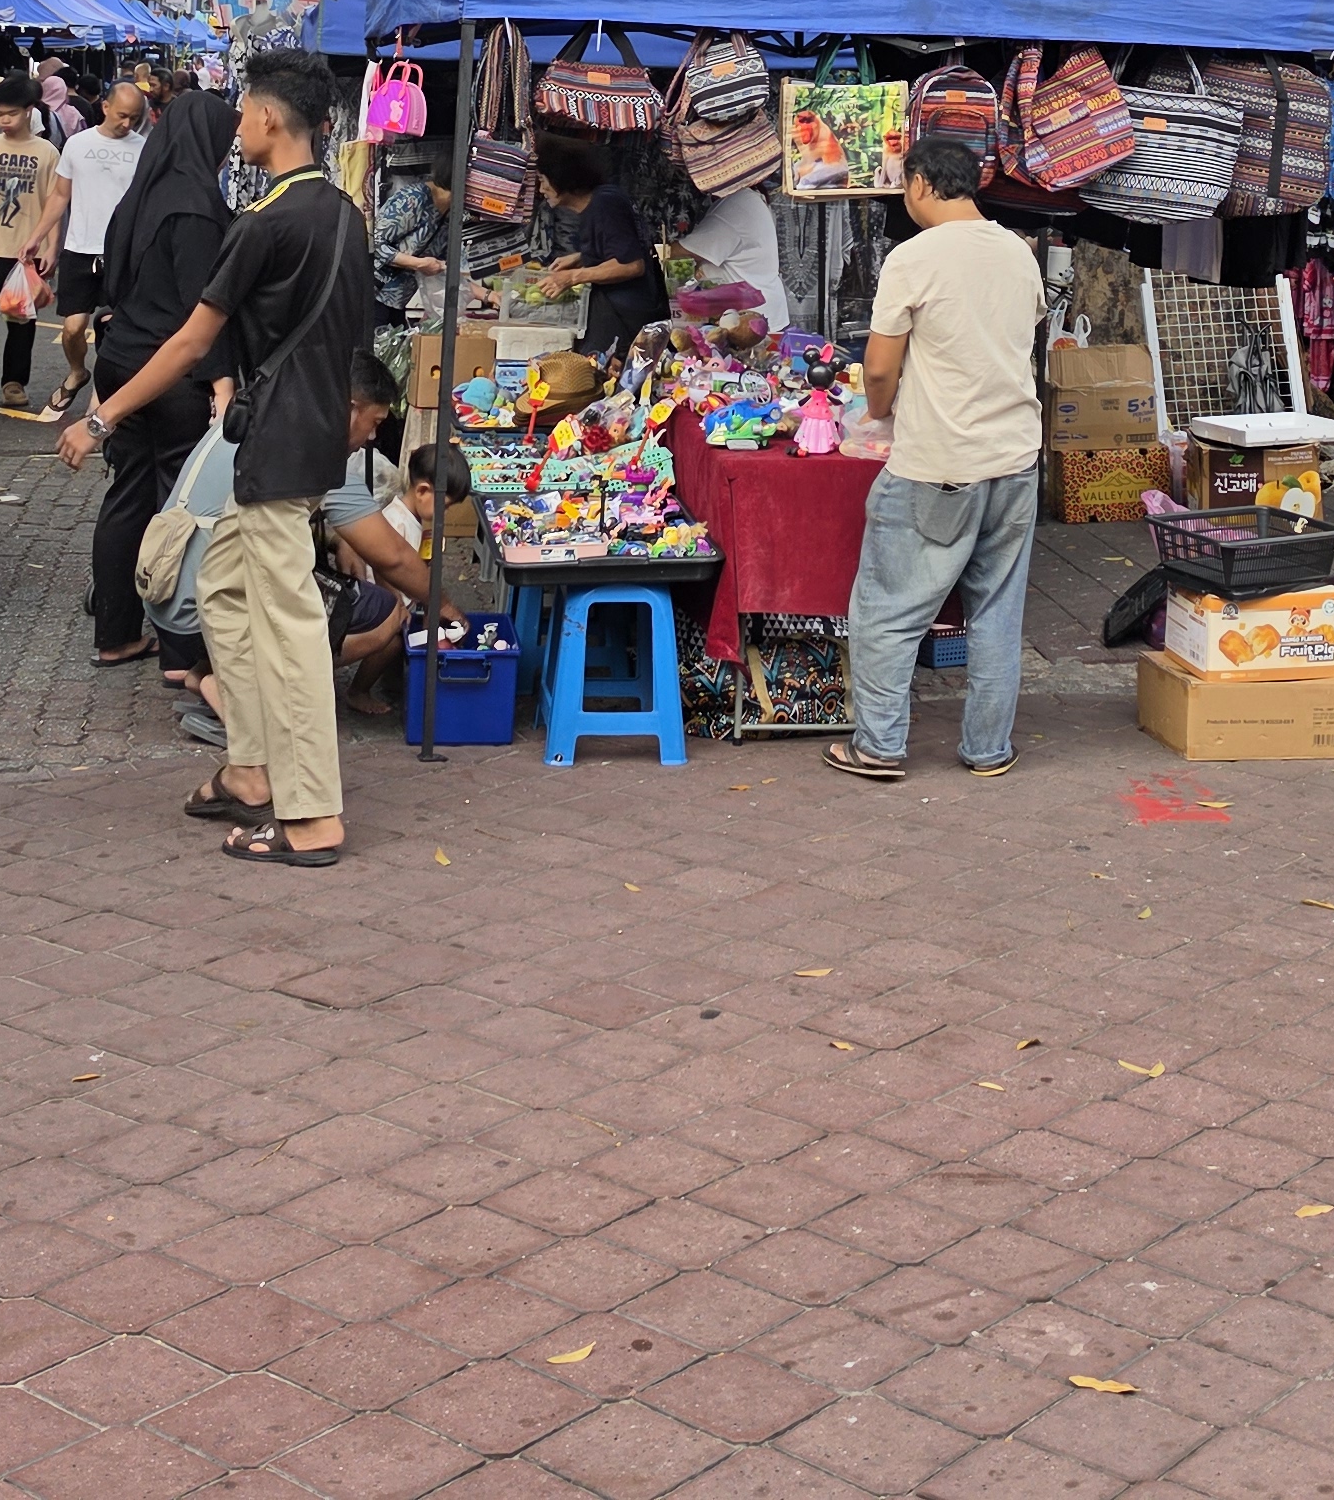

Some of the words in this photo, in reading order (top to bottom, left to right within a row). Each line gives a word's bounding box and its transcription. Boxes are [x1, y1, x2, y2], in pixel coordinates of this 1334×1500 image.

[1127, 395, 1155, 413] 5+1
[1214, 477, 1257, 494] 신고배
[1082, 490, 1124, 501] VALLEY
[1280, 644, 1313, 657] Fruit
